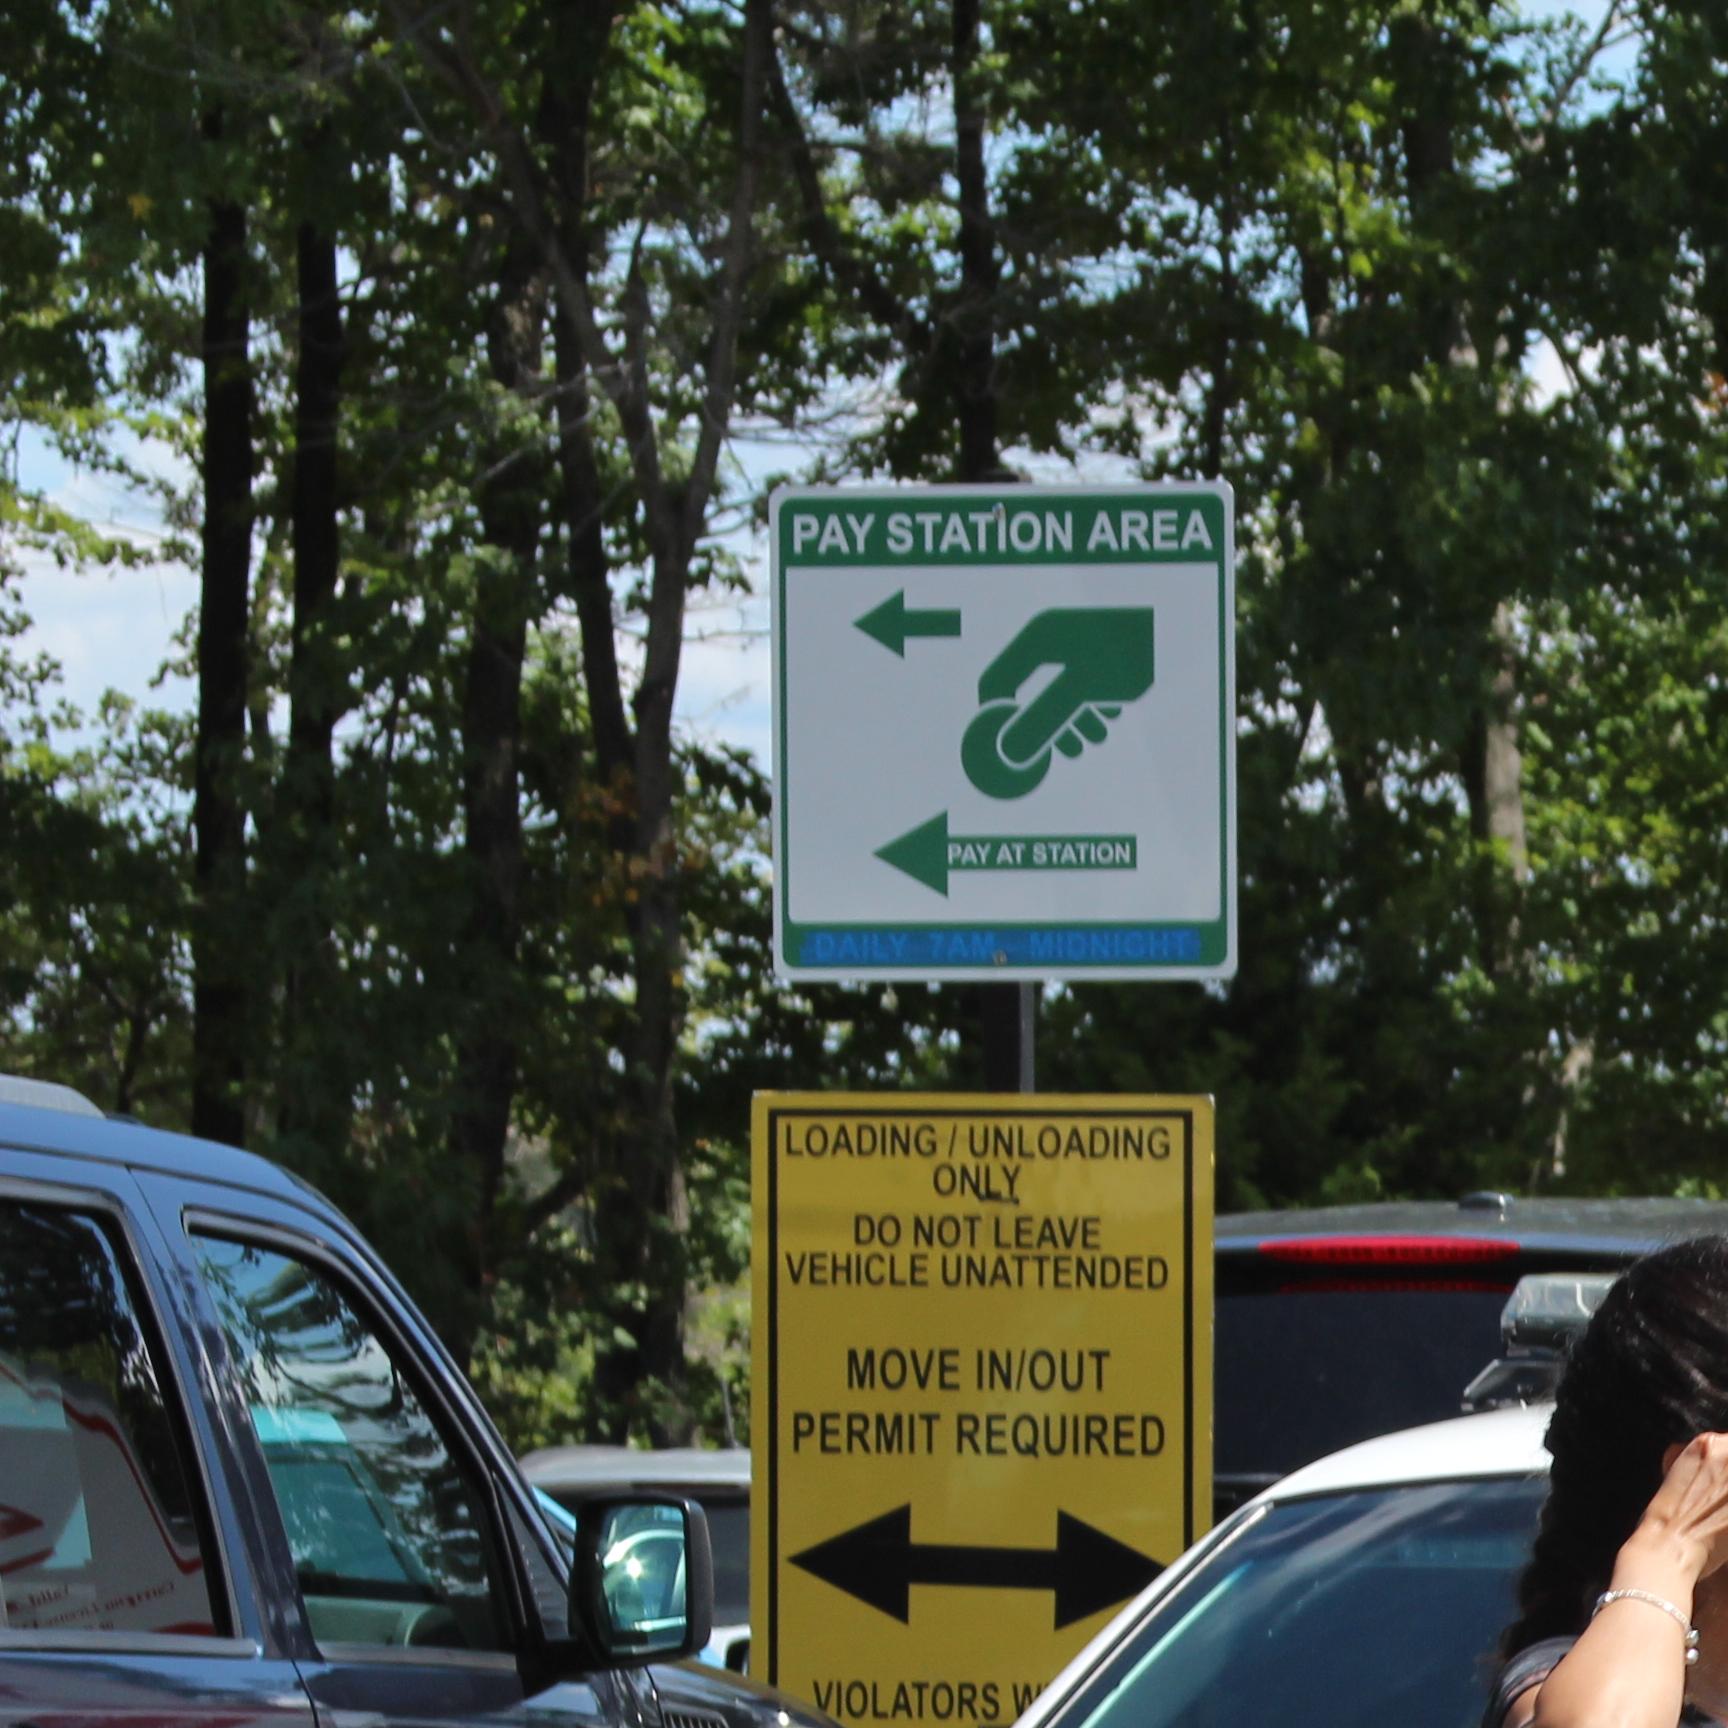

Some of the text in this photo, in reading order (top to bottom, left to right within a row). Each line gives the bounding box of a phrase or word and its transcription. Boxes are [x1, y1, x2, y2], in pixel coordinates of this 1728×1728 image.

[793, 510, 1212, 554] PAY STATION AREA
[948, 842, 1130, 865] PAY AT STATION
[815, 931, 1191, 959] DAILY 7AM MIDNIGHT
[785, 1125, 937, 1158] LOADING
[968, 1125, 1170, 1160] UNLOADING
[933, 1165, 1021, 1197] ONLY
[854, 1216, 1100, 1249] DO NOT LEAVE
[787, 1253, 1169, 1290] VEHICLE UNATTENDED
[847, 1349, 1110, 1392] MOVE IN/OUT
[793, 1413, 1166, 1457] PERMIT REQUIRED
[813, 1681, 1000, 1720] VIOLATORS
